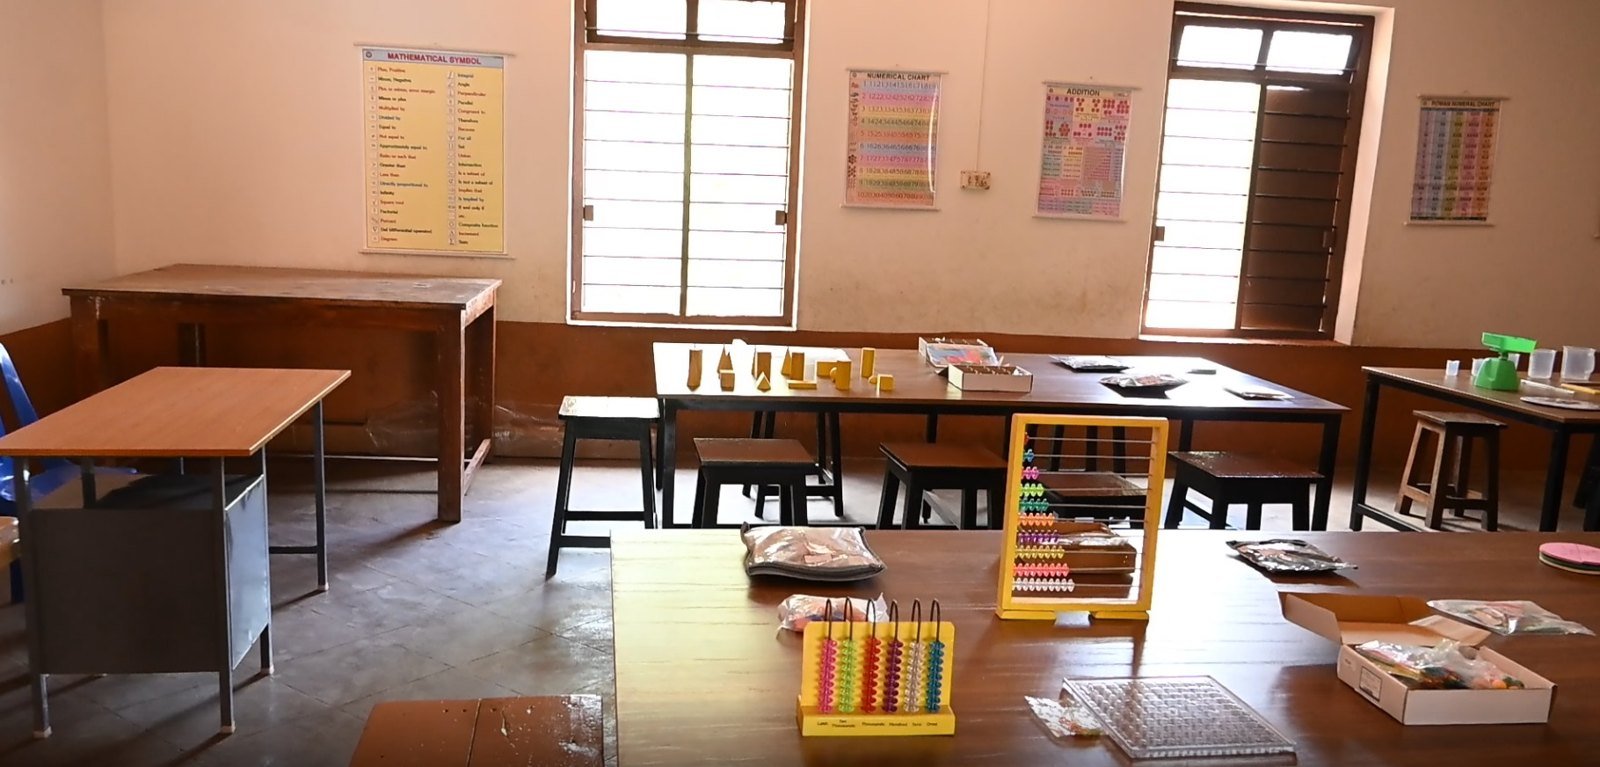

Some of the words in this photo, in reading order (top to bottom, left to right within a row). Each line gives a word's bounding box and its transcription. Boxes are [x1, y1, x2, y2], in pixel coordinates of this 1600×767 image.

[387, 52, 448, 63] MATHEMATICAL
[449, 56, 481, 65] SYMBOL
[1067, 88, 1100, 96] ADDITION
